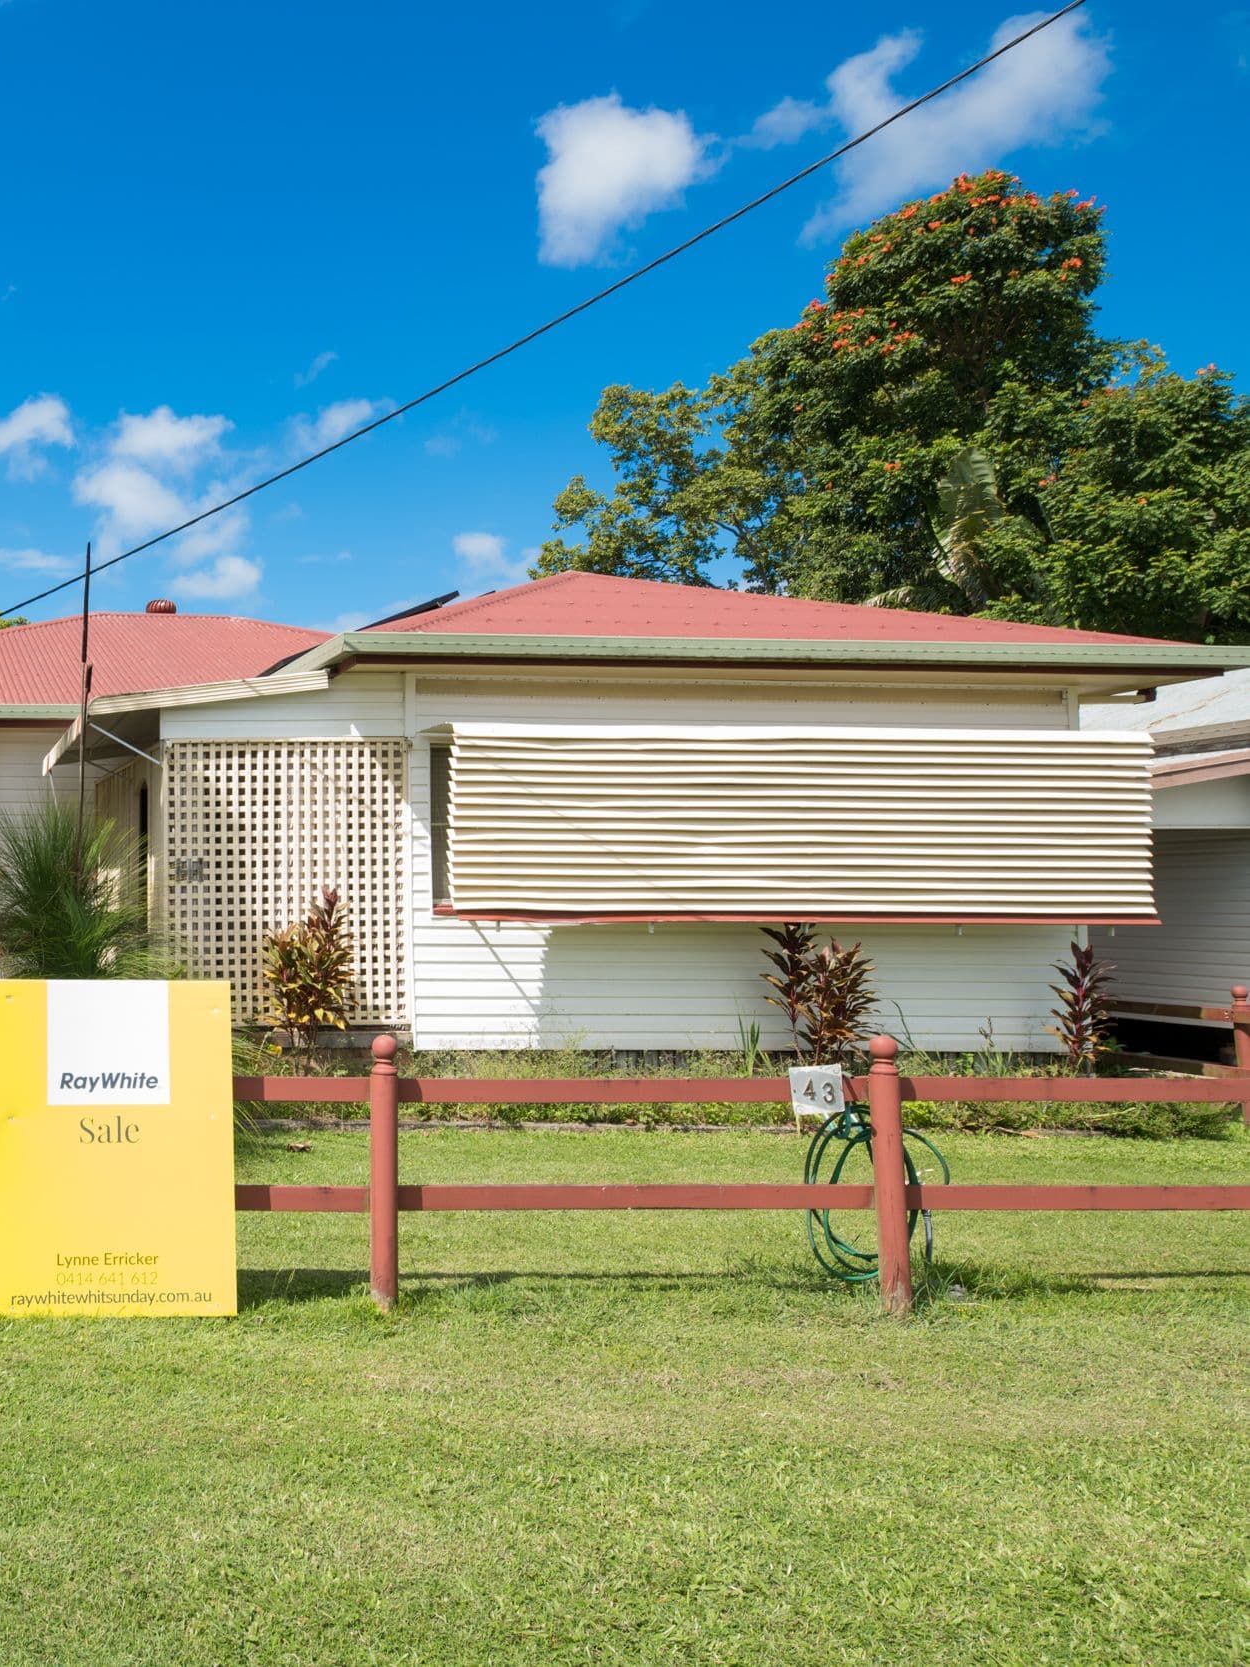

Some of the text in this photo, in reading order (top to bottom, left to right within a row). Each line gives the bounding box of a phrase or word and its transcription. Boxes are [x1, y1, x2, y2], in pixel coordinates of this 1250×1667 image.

[803, 1079, 835, 1104] 43
[79, 1115, 140, 1144] Sale
[56, 1252, 159, 1268] Lynne Erricker
[56, 1271, 159, 1286] 0414 641 612
[11, 1289, 212, 1308] raywhitewhitsunday.com.au
